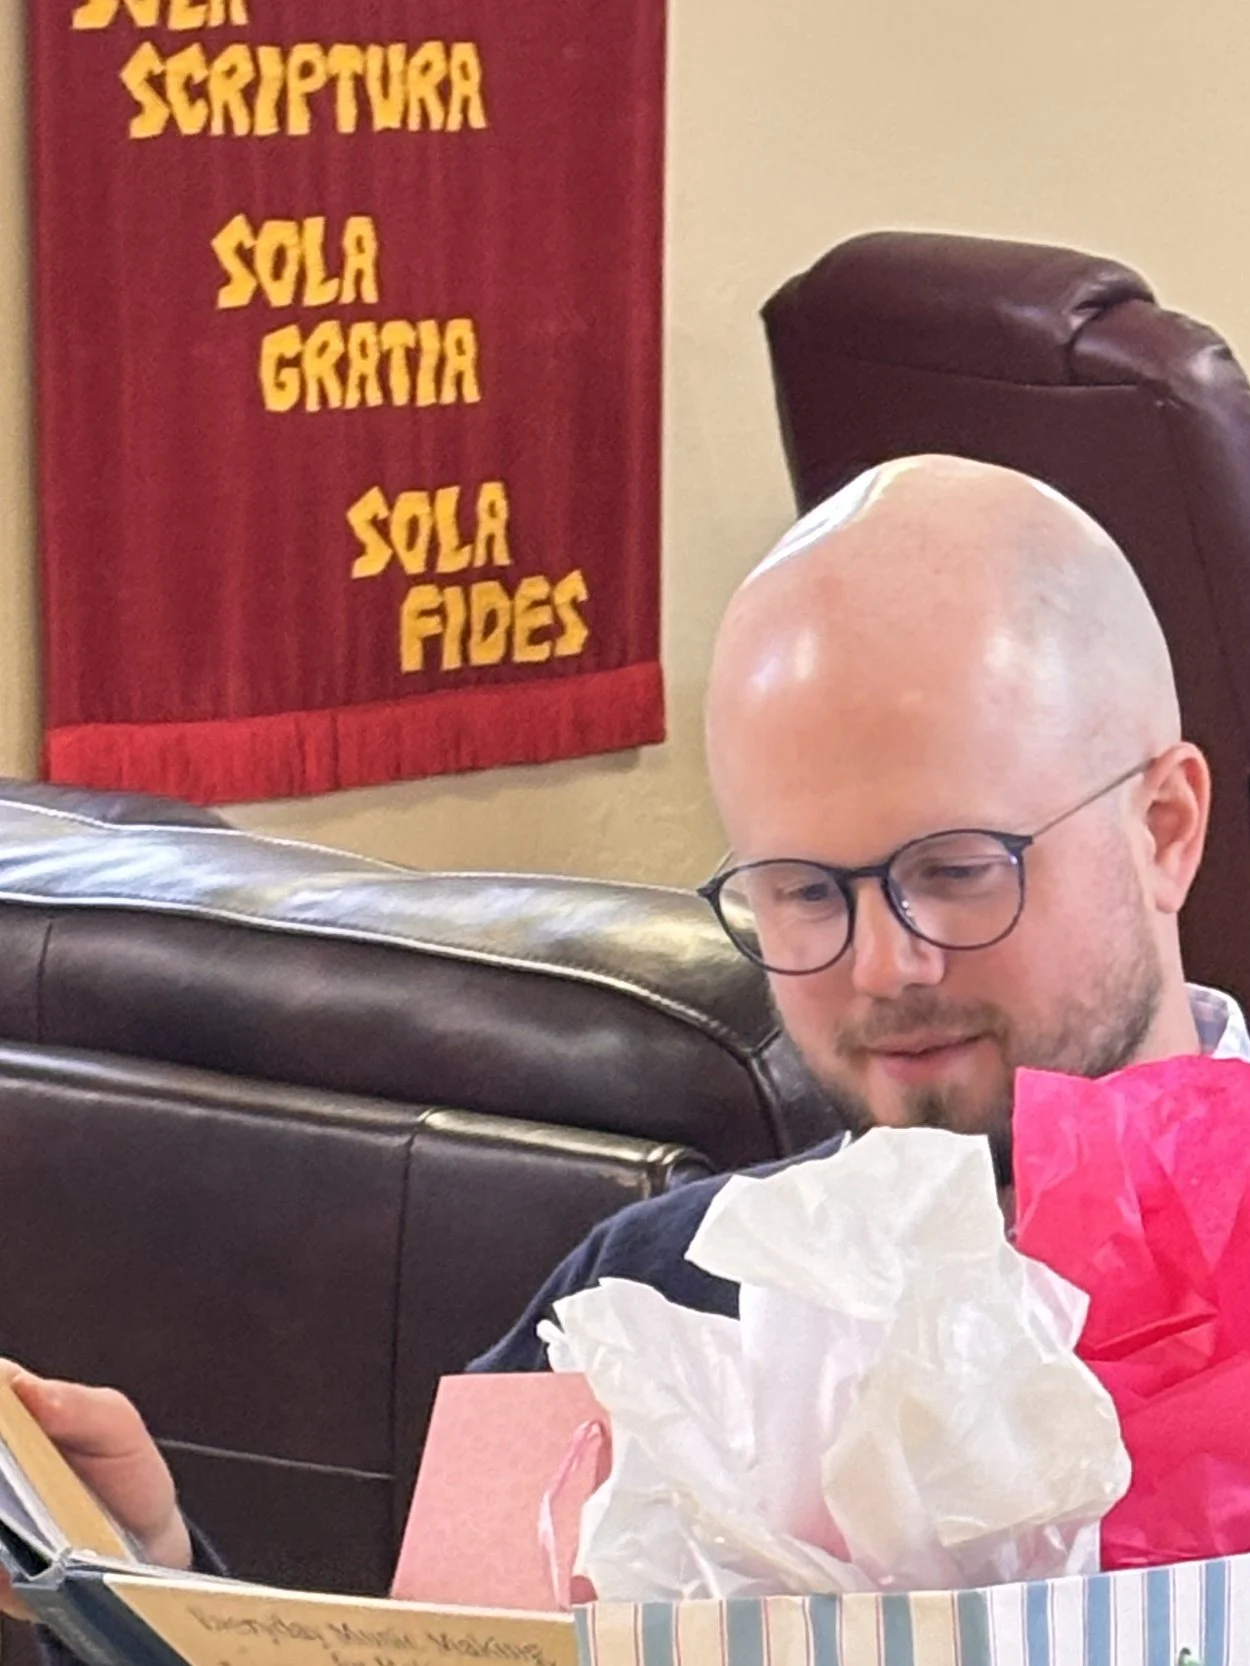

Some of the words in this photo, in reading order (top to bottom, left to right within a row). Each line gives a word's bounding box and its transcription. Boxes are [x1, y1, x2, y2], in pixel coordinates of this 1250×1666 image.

[121, 41, 486, 139] SCRIPTURA
[212, 214, 379, 309] SOLA
[259, 318, 480, 412] GRATIA
[347, 481, 510, 578] SOLA
[400, 570, 589, 673] FIDES
